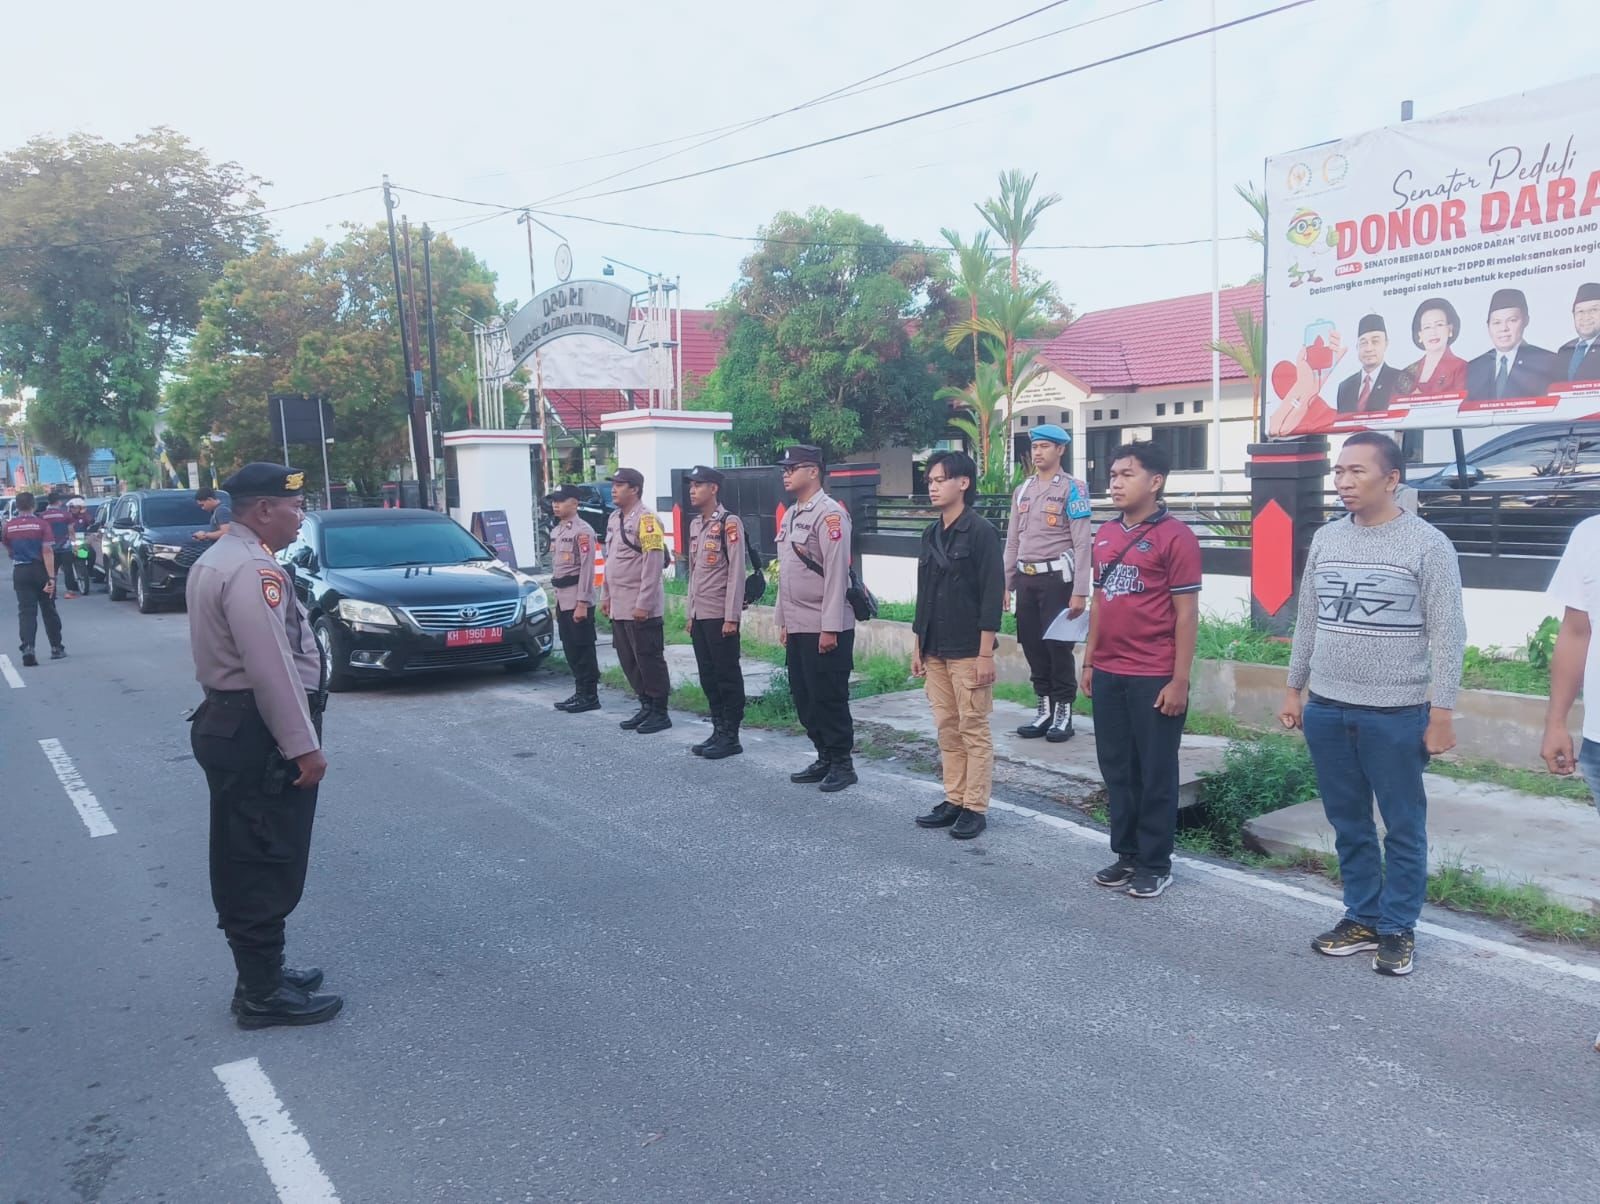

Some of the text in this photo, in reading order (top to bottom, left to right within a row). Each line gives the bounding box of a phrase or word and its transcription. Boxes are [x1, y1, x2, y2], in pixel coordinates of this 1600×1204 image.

[1393, 134, 1577, 210] Senator Peduli
[1335, 198, 1467, 260] DONOR
[1364, 256, 1398, 269] SENATOR
[1399, 252, 1433, 263] BERBAGI
[1434, 248, 1451, 258] DAN
[1453, 242, 1483, 255] DONOR
[1484, 237, 1515, 249] DARAH
[1543, 226, 1574, 239] BLOOD
[1576, 222, 1598, 234] AND
[1333, 279, 1363, 291] rangka
[1363, 269, 1422, 285] memperingati
[1424, 267, 1440, 277] HUT
[1467, 259, 1485, 270] DPD
[1487, 258, 1495, 267] RI
[1497, 247, 1572, 264] melaksanakan
[1383, 259, 1585, 297] sebagai salah satu bentuk kepedulian sosial
[448, 630, 459, 641] KH
[465, 628, 486, 640] 1960
